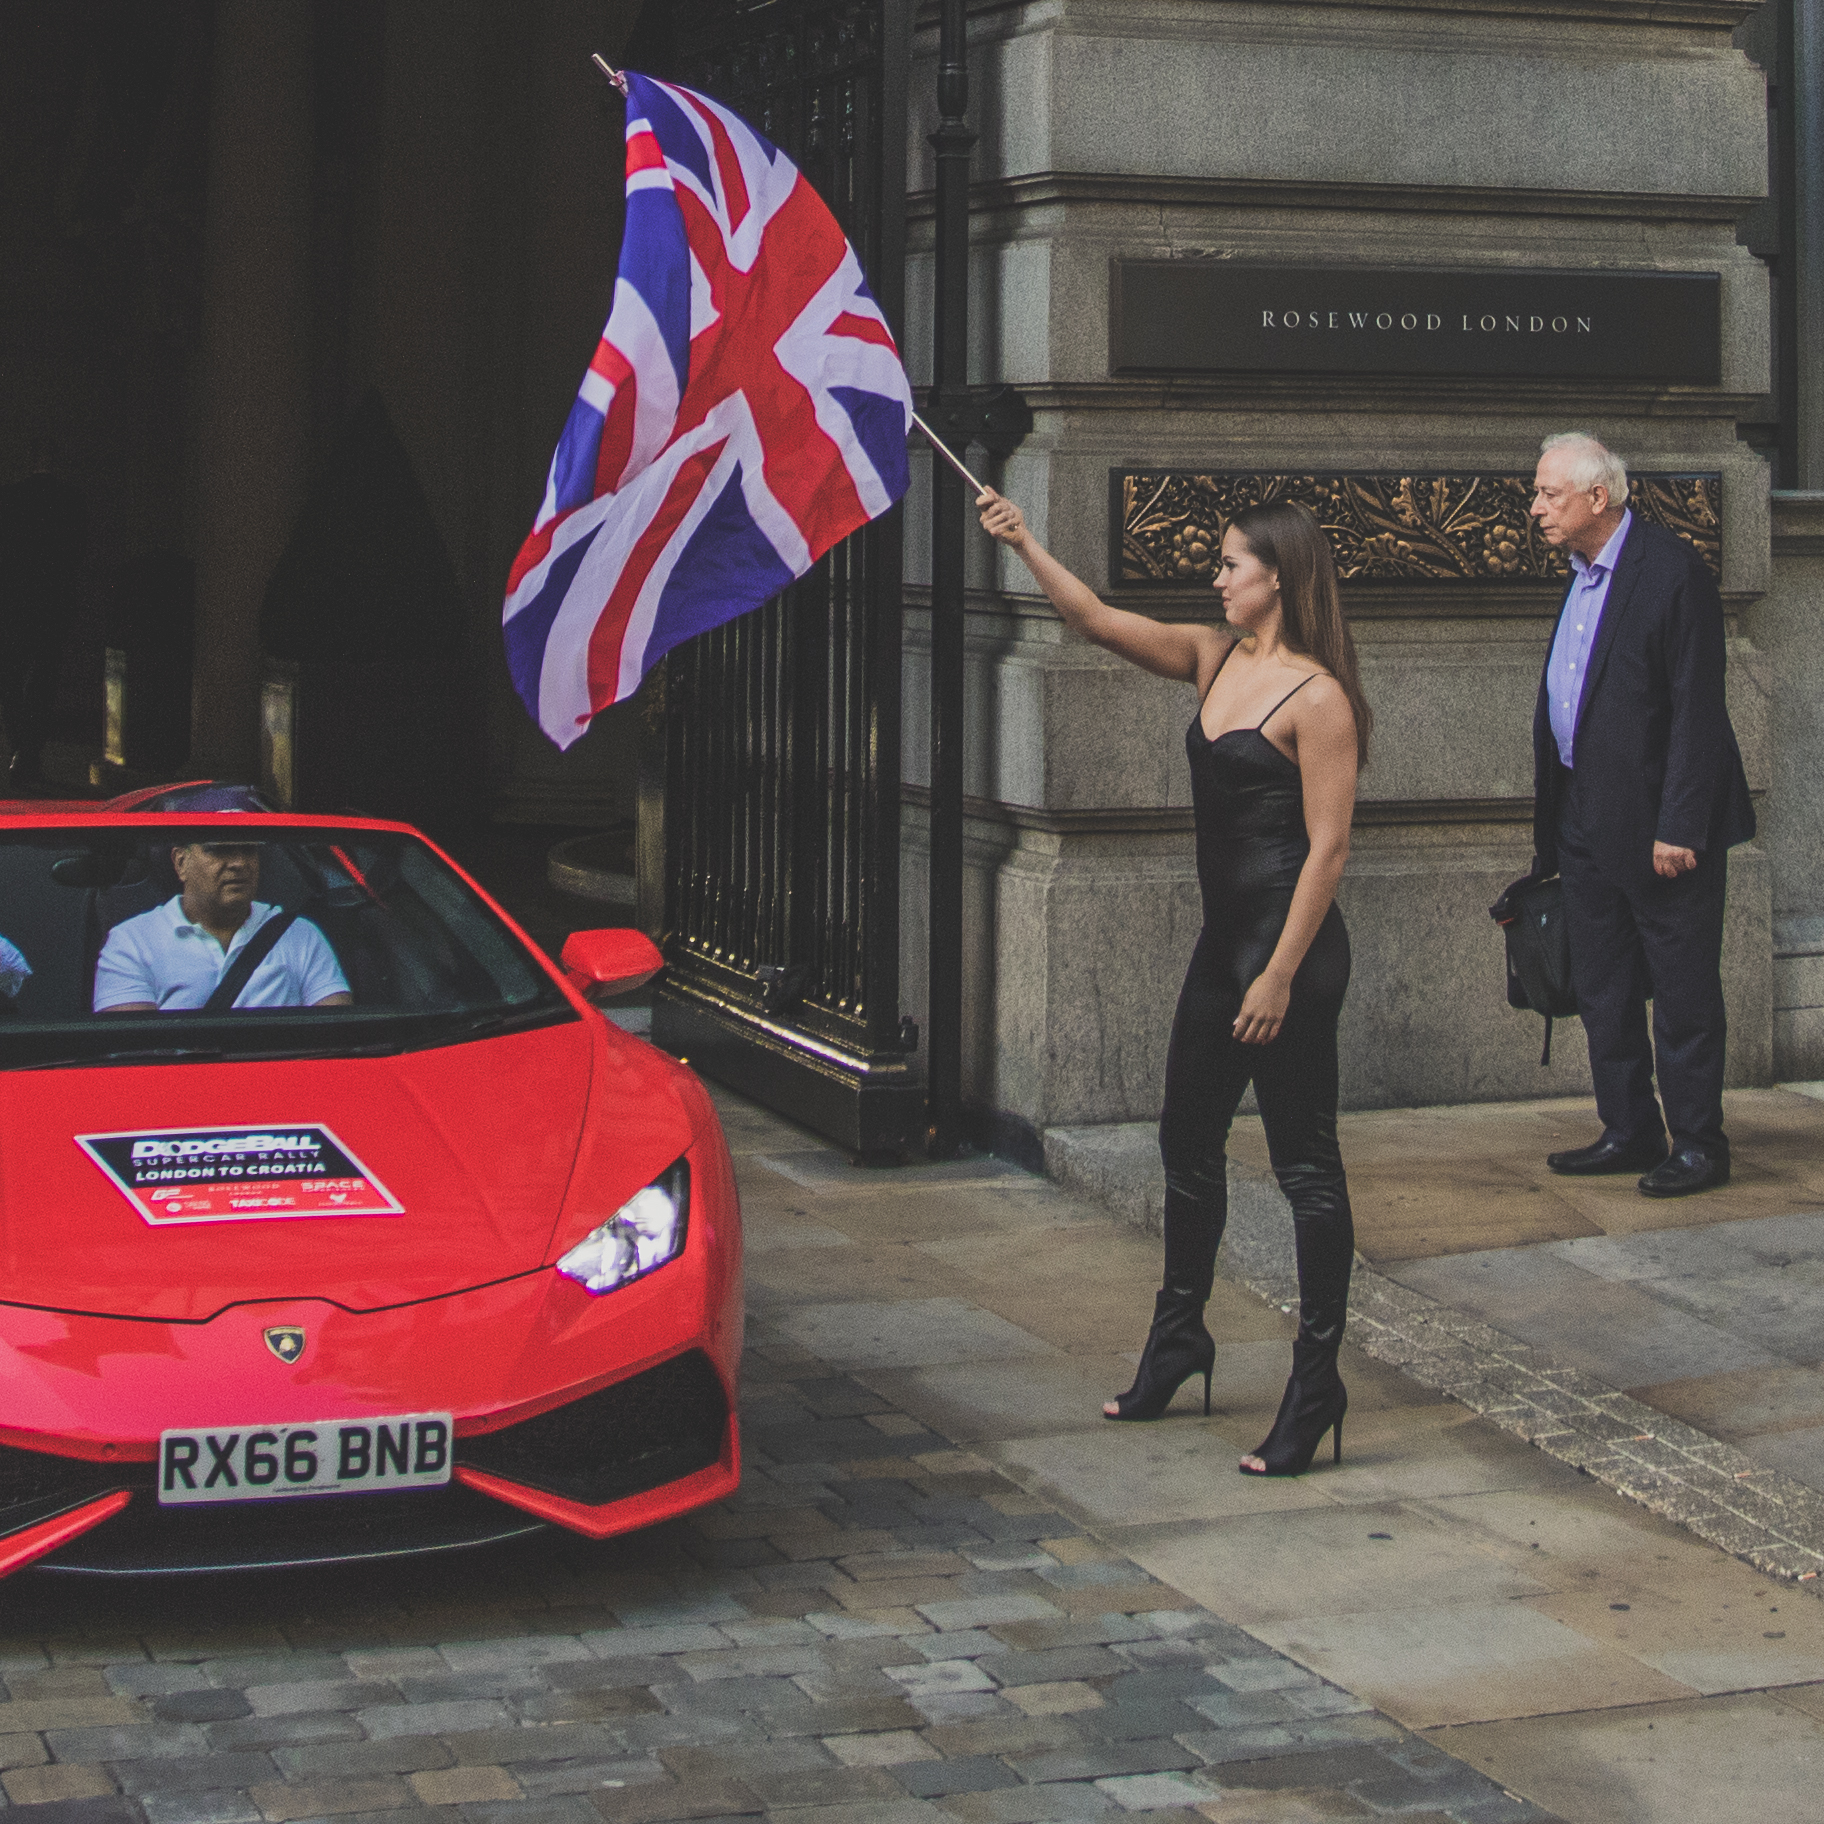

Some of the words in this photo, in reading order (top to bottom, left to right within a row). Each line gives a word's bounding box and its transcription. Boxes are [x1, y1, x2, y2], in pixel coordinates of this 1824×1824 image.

[1261, 309, 1443, 332] ROSEWOOD
[1462, 314, 1593, 334] LONDON
[133, 1152, 246, 1167] SUPERCAR
[259, 1150, 321, 1162] RALLY
[135, 1166, 216, 1182] LONDON
[218, 1165, 244, 1178] TO
[246, 1162, 326, 1176] CROATIA
[301, 1179, 364, 1189] SPACE
[162, 1430, 318, 1490] RX66
[337, 1420, 448, 1479] BNB
